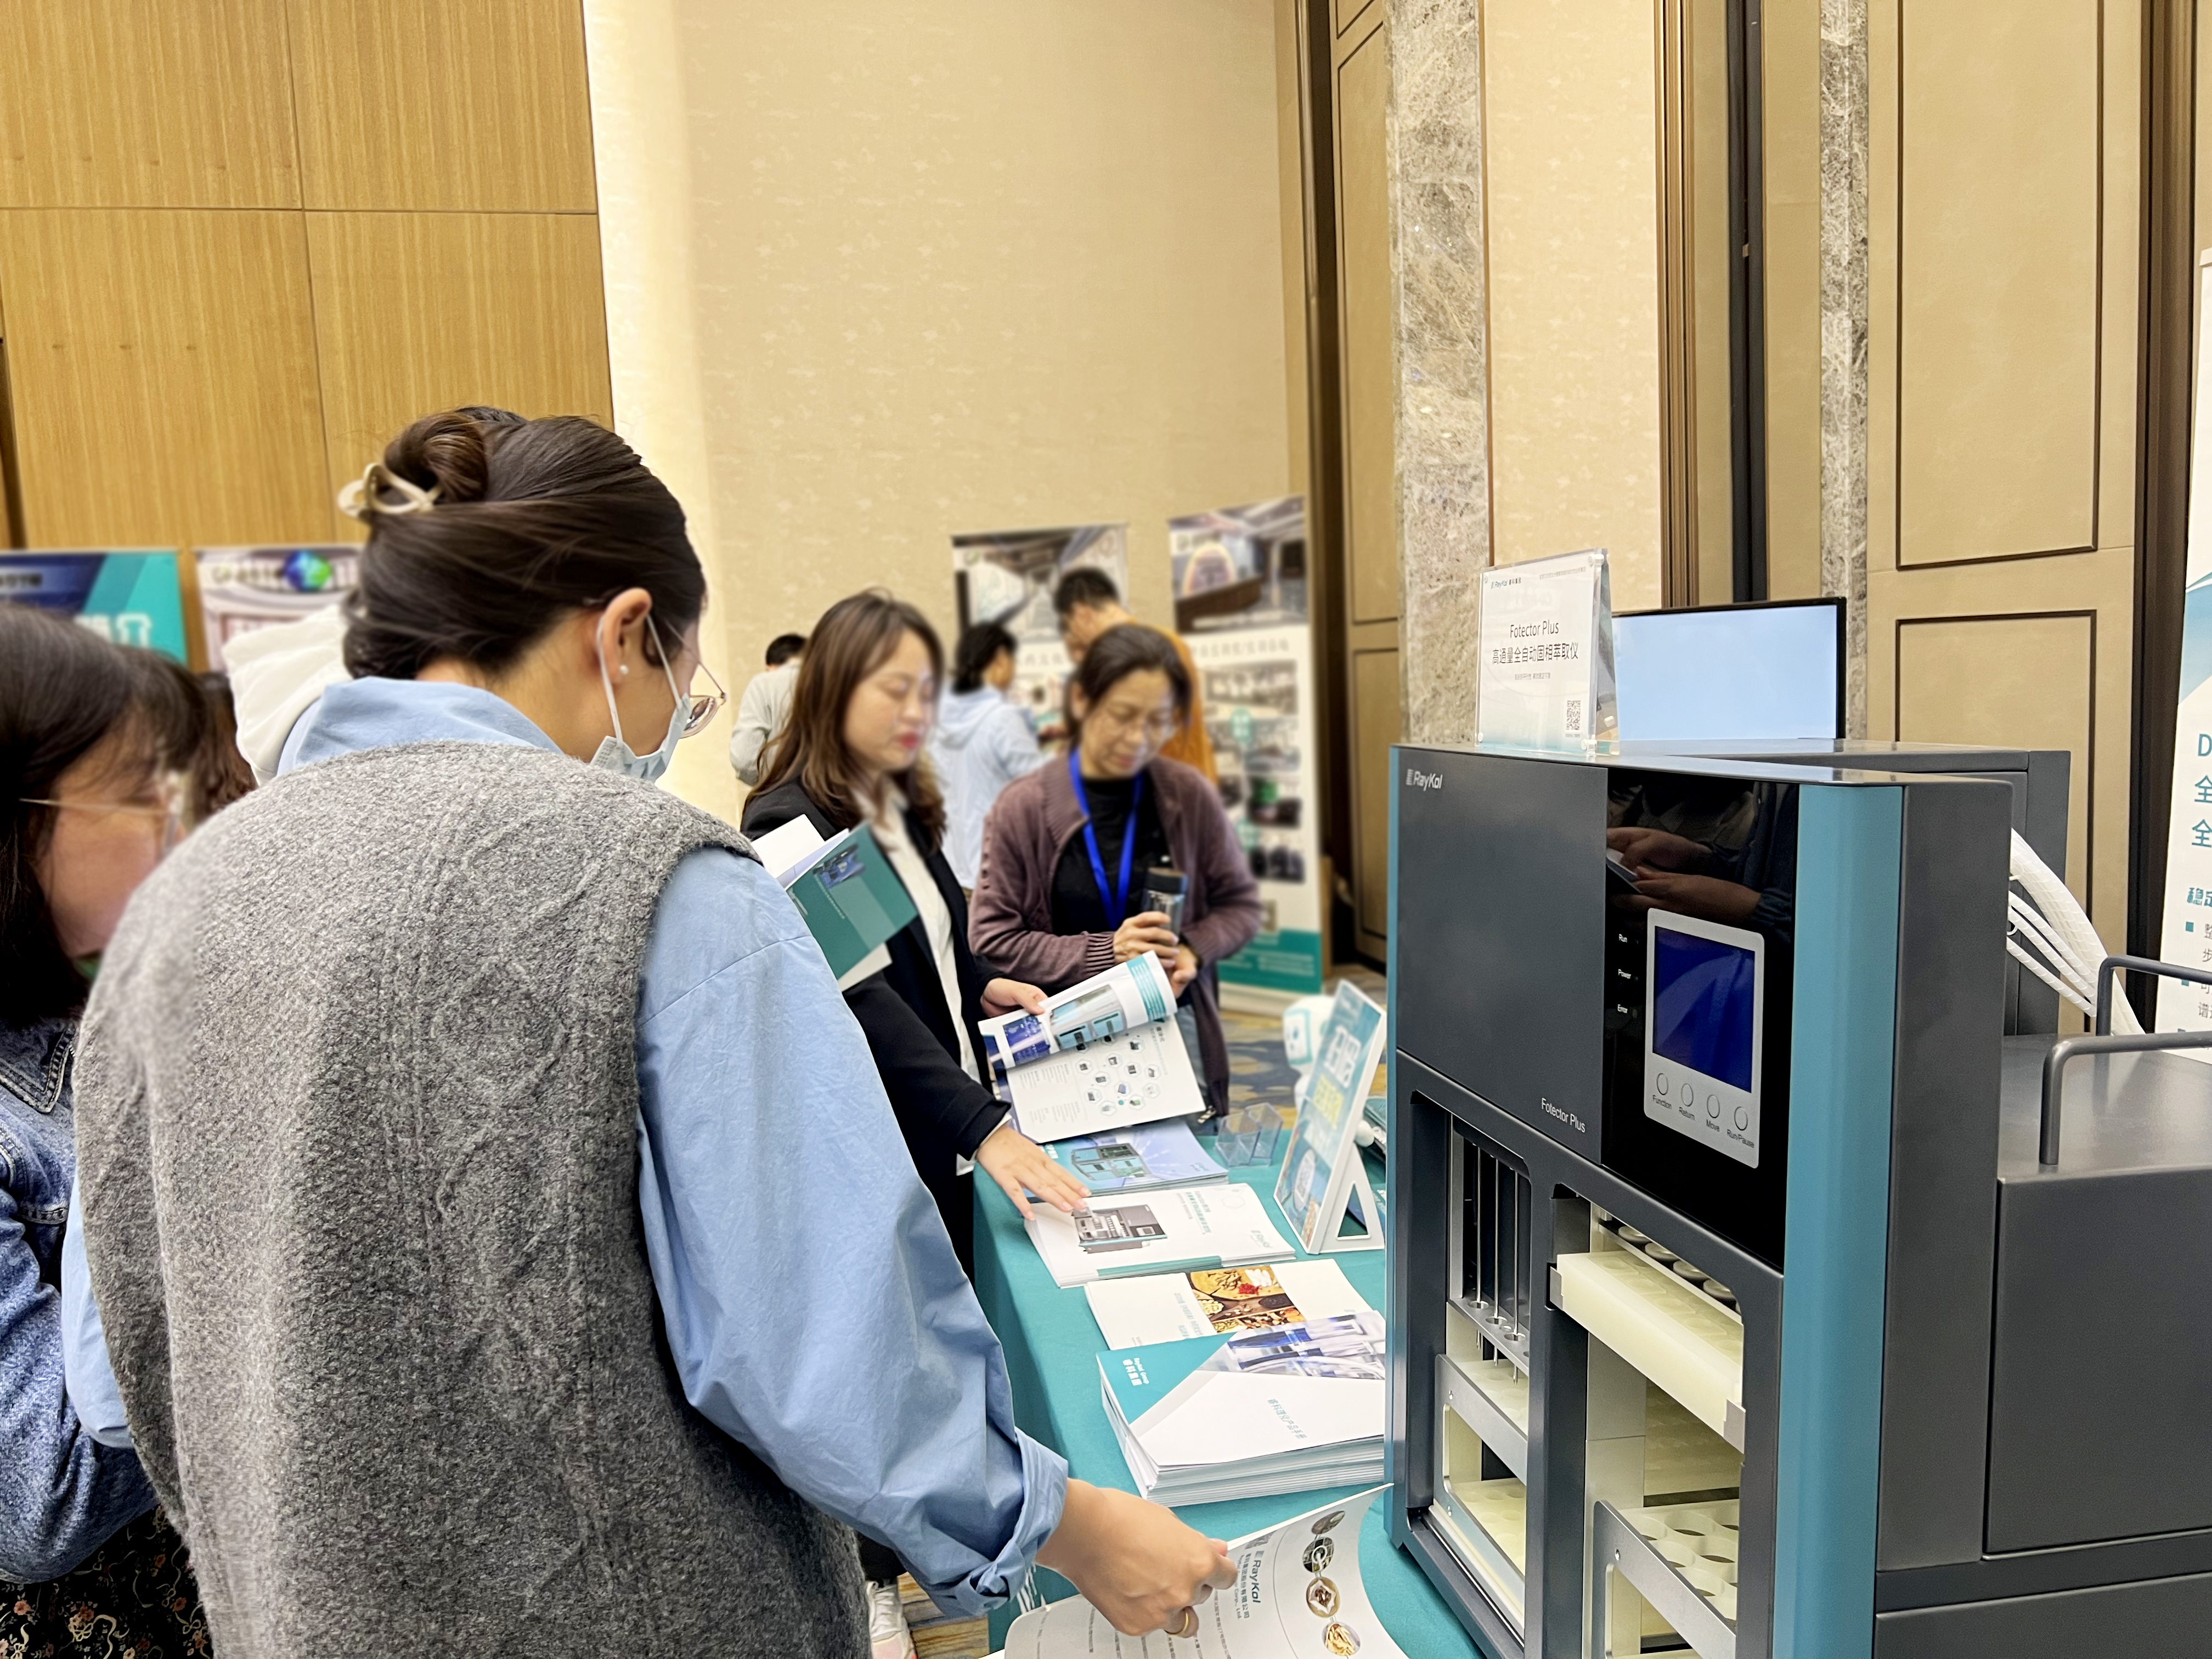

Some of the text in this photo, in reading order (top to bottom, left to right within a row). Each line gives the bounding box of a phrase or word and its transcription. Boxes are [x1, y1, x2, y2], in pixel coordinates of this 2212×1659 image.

[1510, 619, 1559, 638] Fotector Plus
[1492, 642, 1578, 664] 高通量全自动固相萃取仪
[1413, 771, 1443, 791] RayKol
[1652, 1094, 1672, 1109] Function
[1542, 1098, 1585, 1133] Fotector Plus
[1679, 1107, 1695, 1120] Return
[1706, 1119, 1720, 1132] Move
[1249, 1560, 1261, 1602] RayKol
